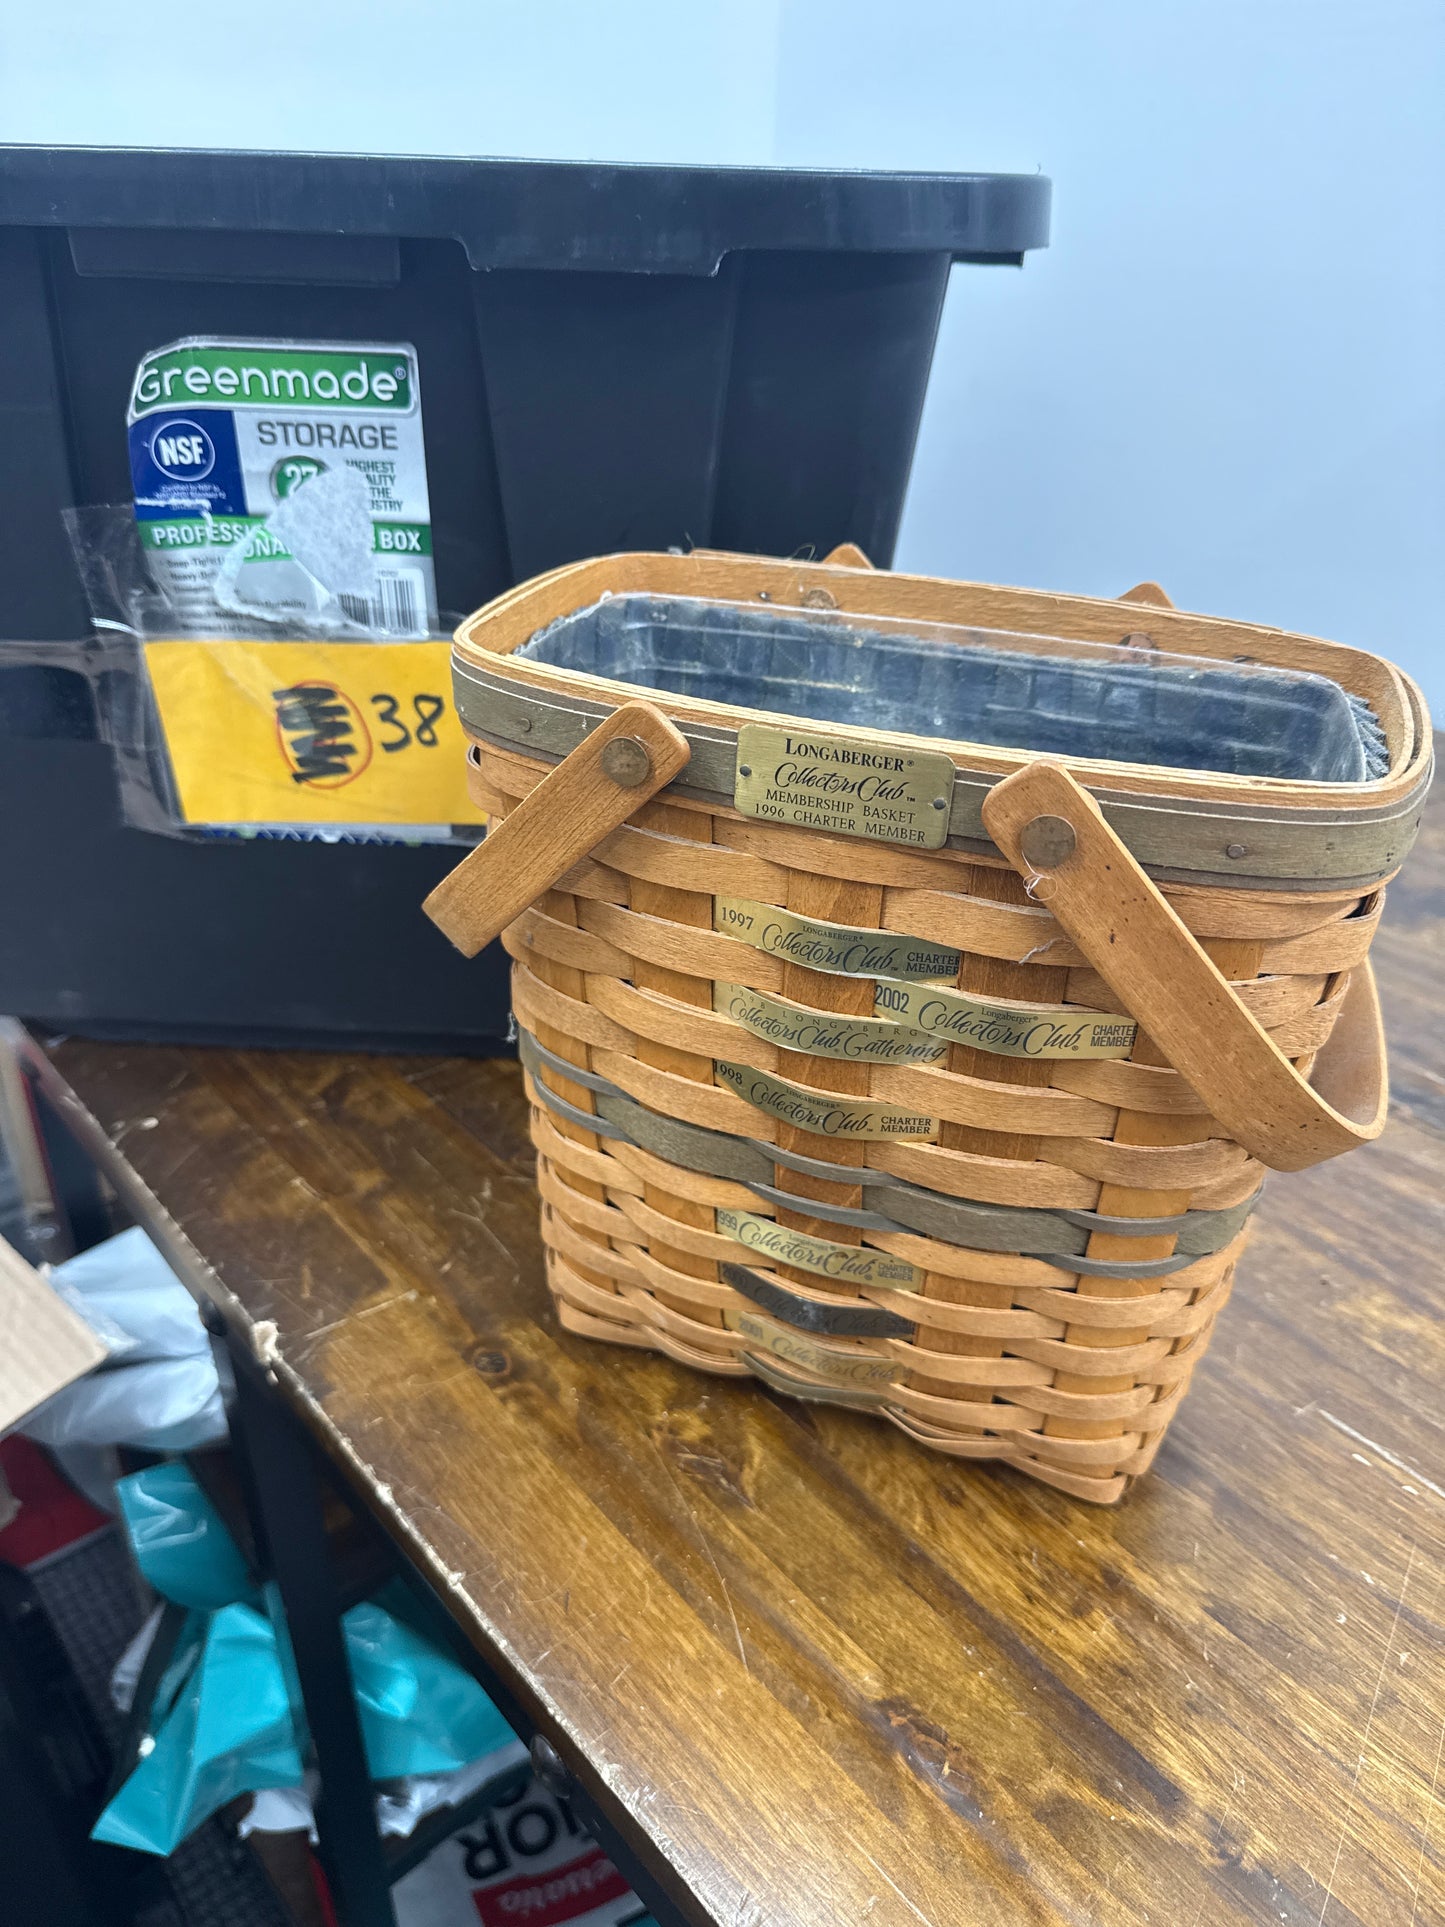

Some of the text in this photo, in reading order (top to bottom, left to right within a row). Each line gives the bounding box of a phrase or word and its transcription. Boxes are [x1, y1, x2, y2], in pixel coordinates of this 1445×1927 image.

[258, 421, 399, 450] STORAGE
[379, 528, 422, 552] BOX
[370, 693, 445, 753] 38
[774, 762, 858, 793] Collectors
[754, 803, 926, 843] 1996 CHARTER MEMBER
[765, 788, 916, 825] MEMBERSHIP BASKET
[721, 906, 754, 931] 1997
[762, 923, 843, 965] Collectors
[729, 997, 799, 1040] Collectors
[843, 1032, 946, 1064] Gathering
[875, 983, 911, 1015] 2002
[918, 1000, 1026, 1048] Collectors
[713, 1060, 744, 1086] 1998
[750, 1081, 824, 1124] Collectors
[880, 1115, 932, 1127] CHARTER
[880, 1124, 931, 1135] MEMBER
[738, 1221, 823, 1264] Collectors
